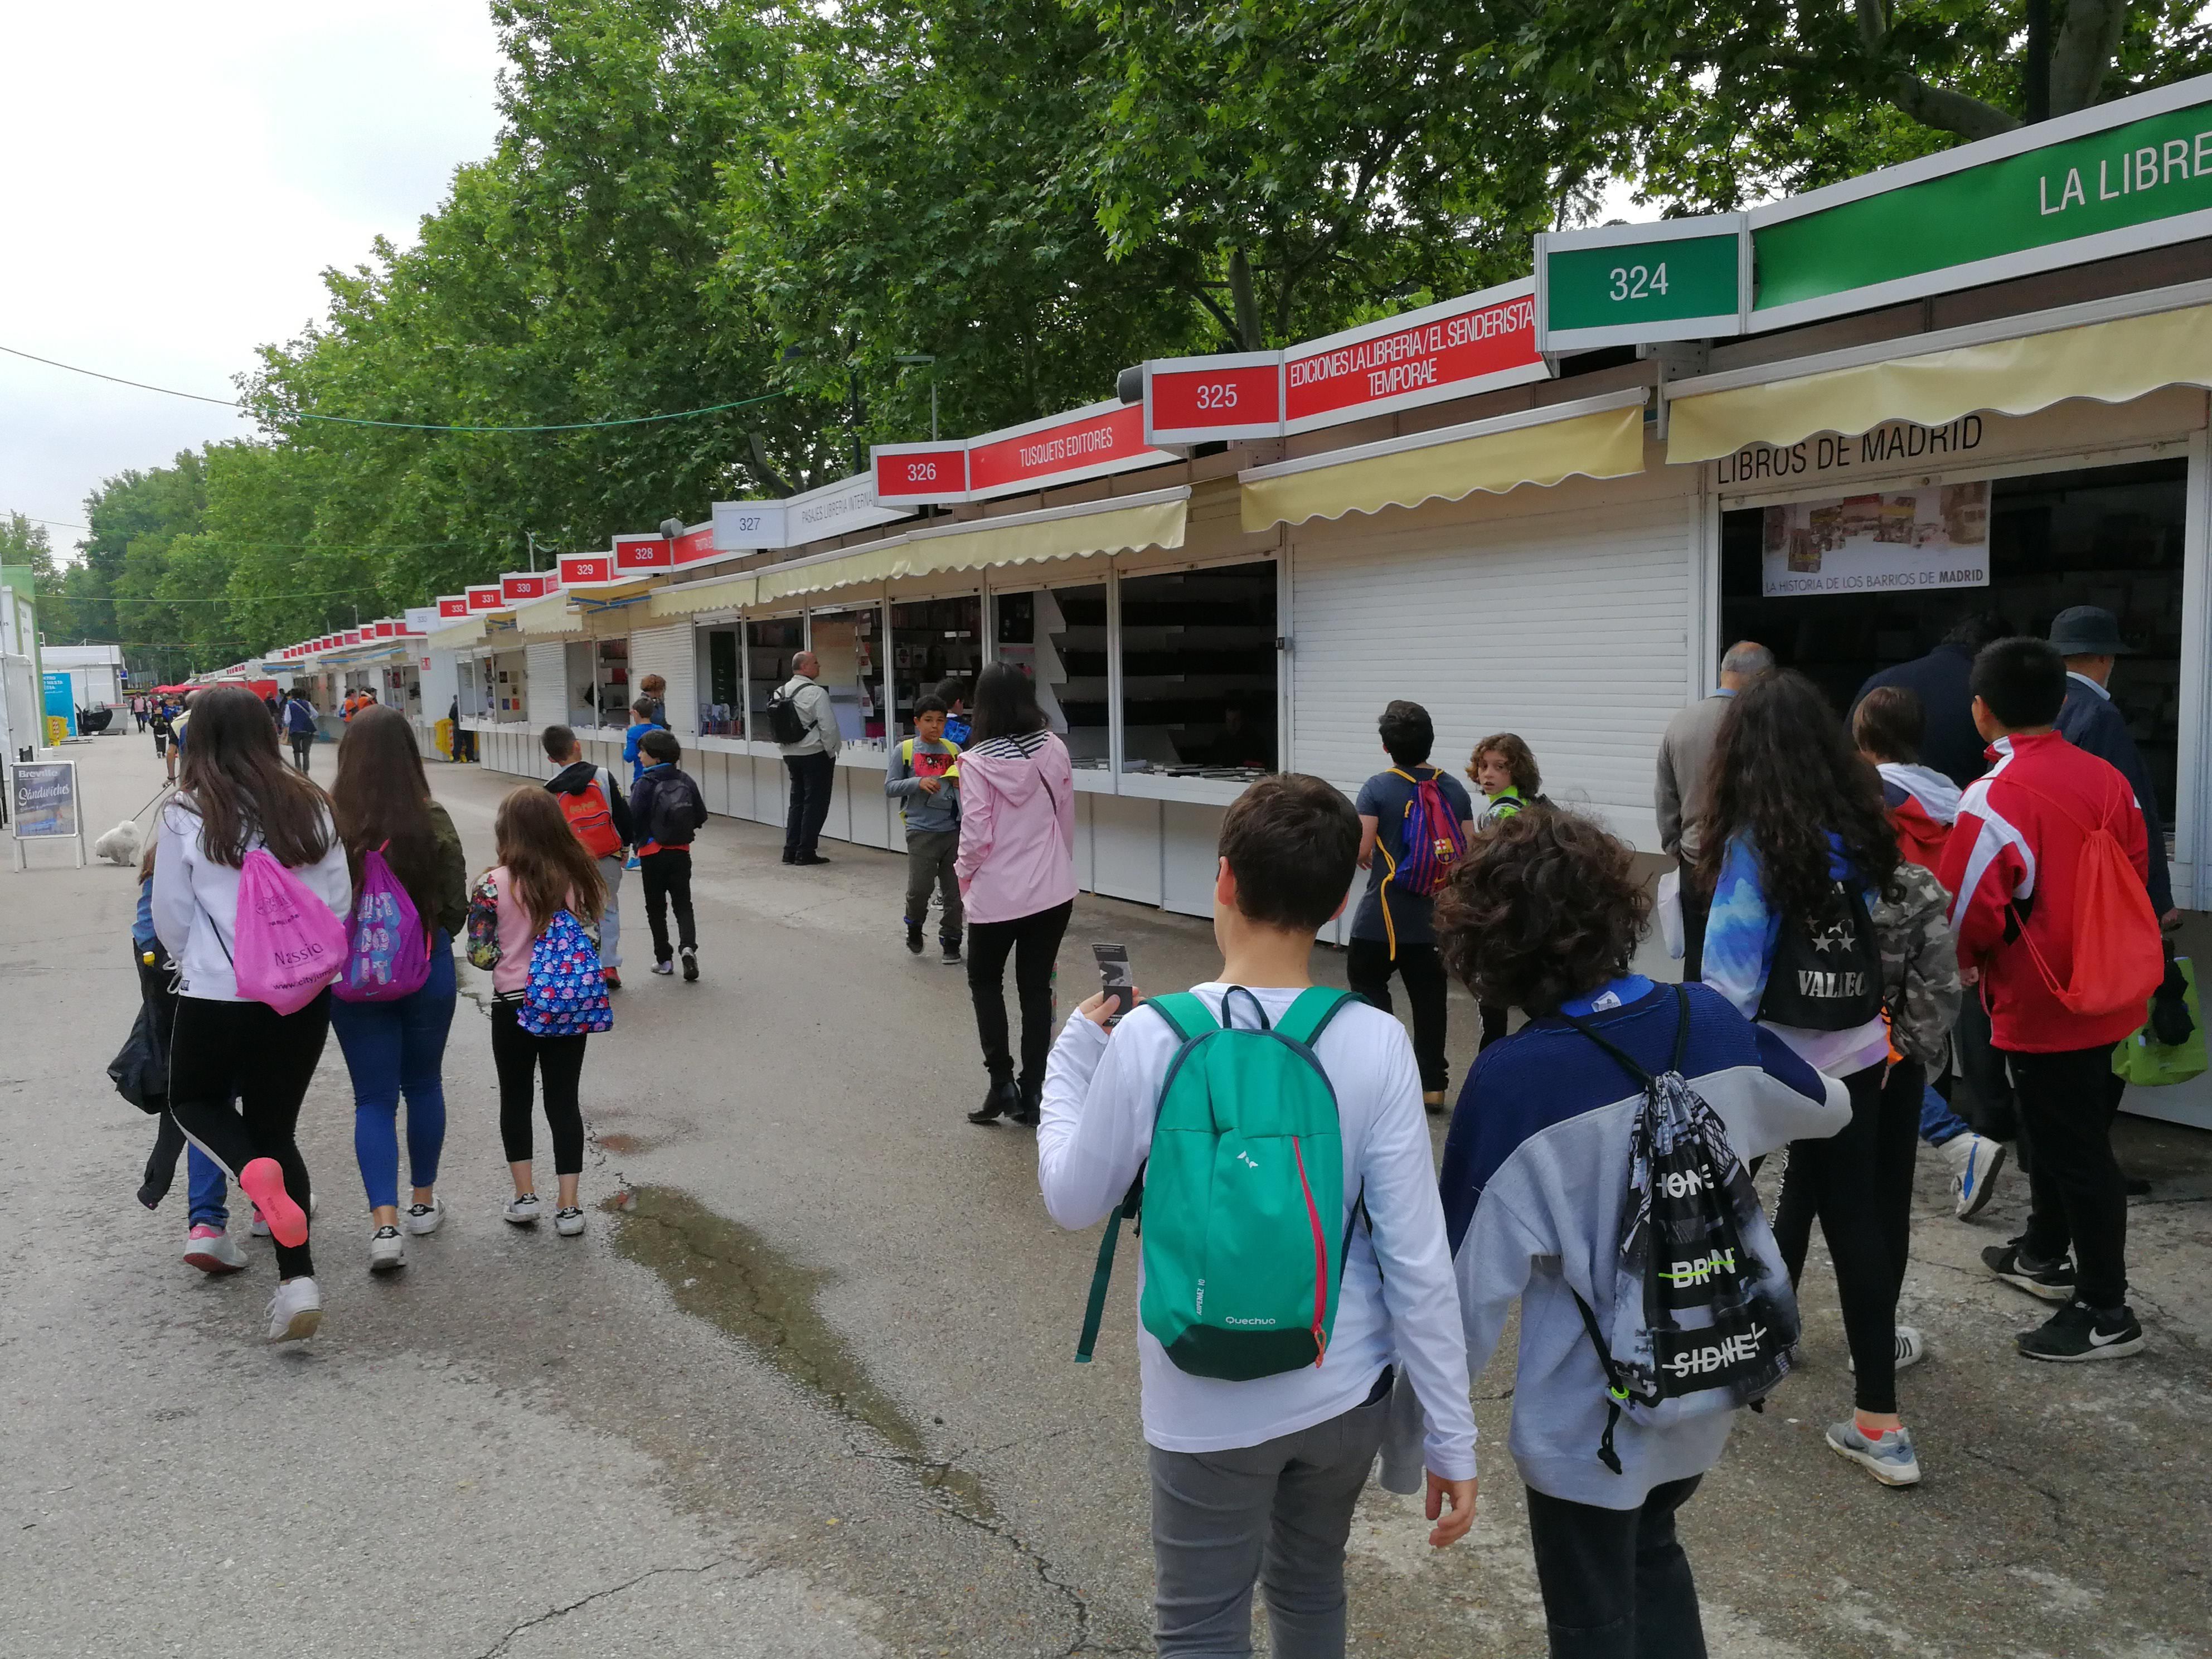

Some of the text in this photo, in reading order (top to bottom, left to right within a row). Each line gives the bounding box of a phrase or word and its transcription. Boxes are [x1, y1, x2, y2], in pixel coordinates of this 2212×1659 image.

[2040, 131, 2212, 216] LA LIBRE
[1609, 262, 1669, 302] 324
[1290, 351, 1349, 388] EDICIONES
[1350, 346, 1366, 372] LA
[1447, 300, 1535, 348] SENDERISTA
[1367, 357, 1437, 397] TEMPORAE
[1196, 384, 1238, 410] 325
[1020, 426, 1113, 467] TUSQUETS EDITORES
[1718, 415, 1983, 484] LIBROS DE MADRID
[907, 462, 937, 482] 326
[739, 517, 761, 531] 327
[635, 547, 653, 560] 328
[576, 564, 594, 575] 329
[1766, 569, 1983, 593] LA HISTORIA DE LOS BARRIOS DE MADRID
[482, 594, 494, 603] 331
[516, 583, 531, 593] 330
[451, 604, 464, 613] 332
[1225, 1316, 1276, 1325] Quechua
[1673, 1322, 1767, 1378] SIDNEY
